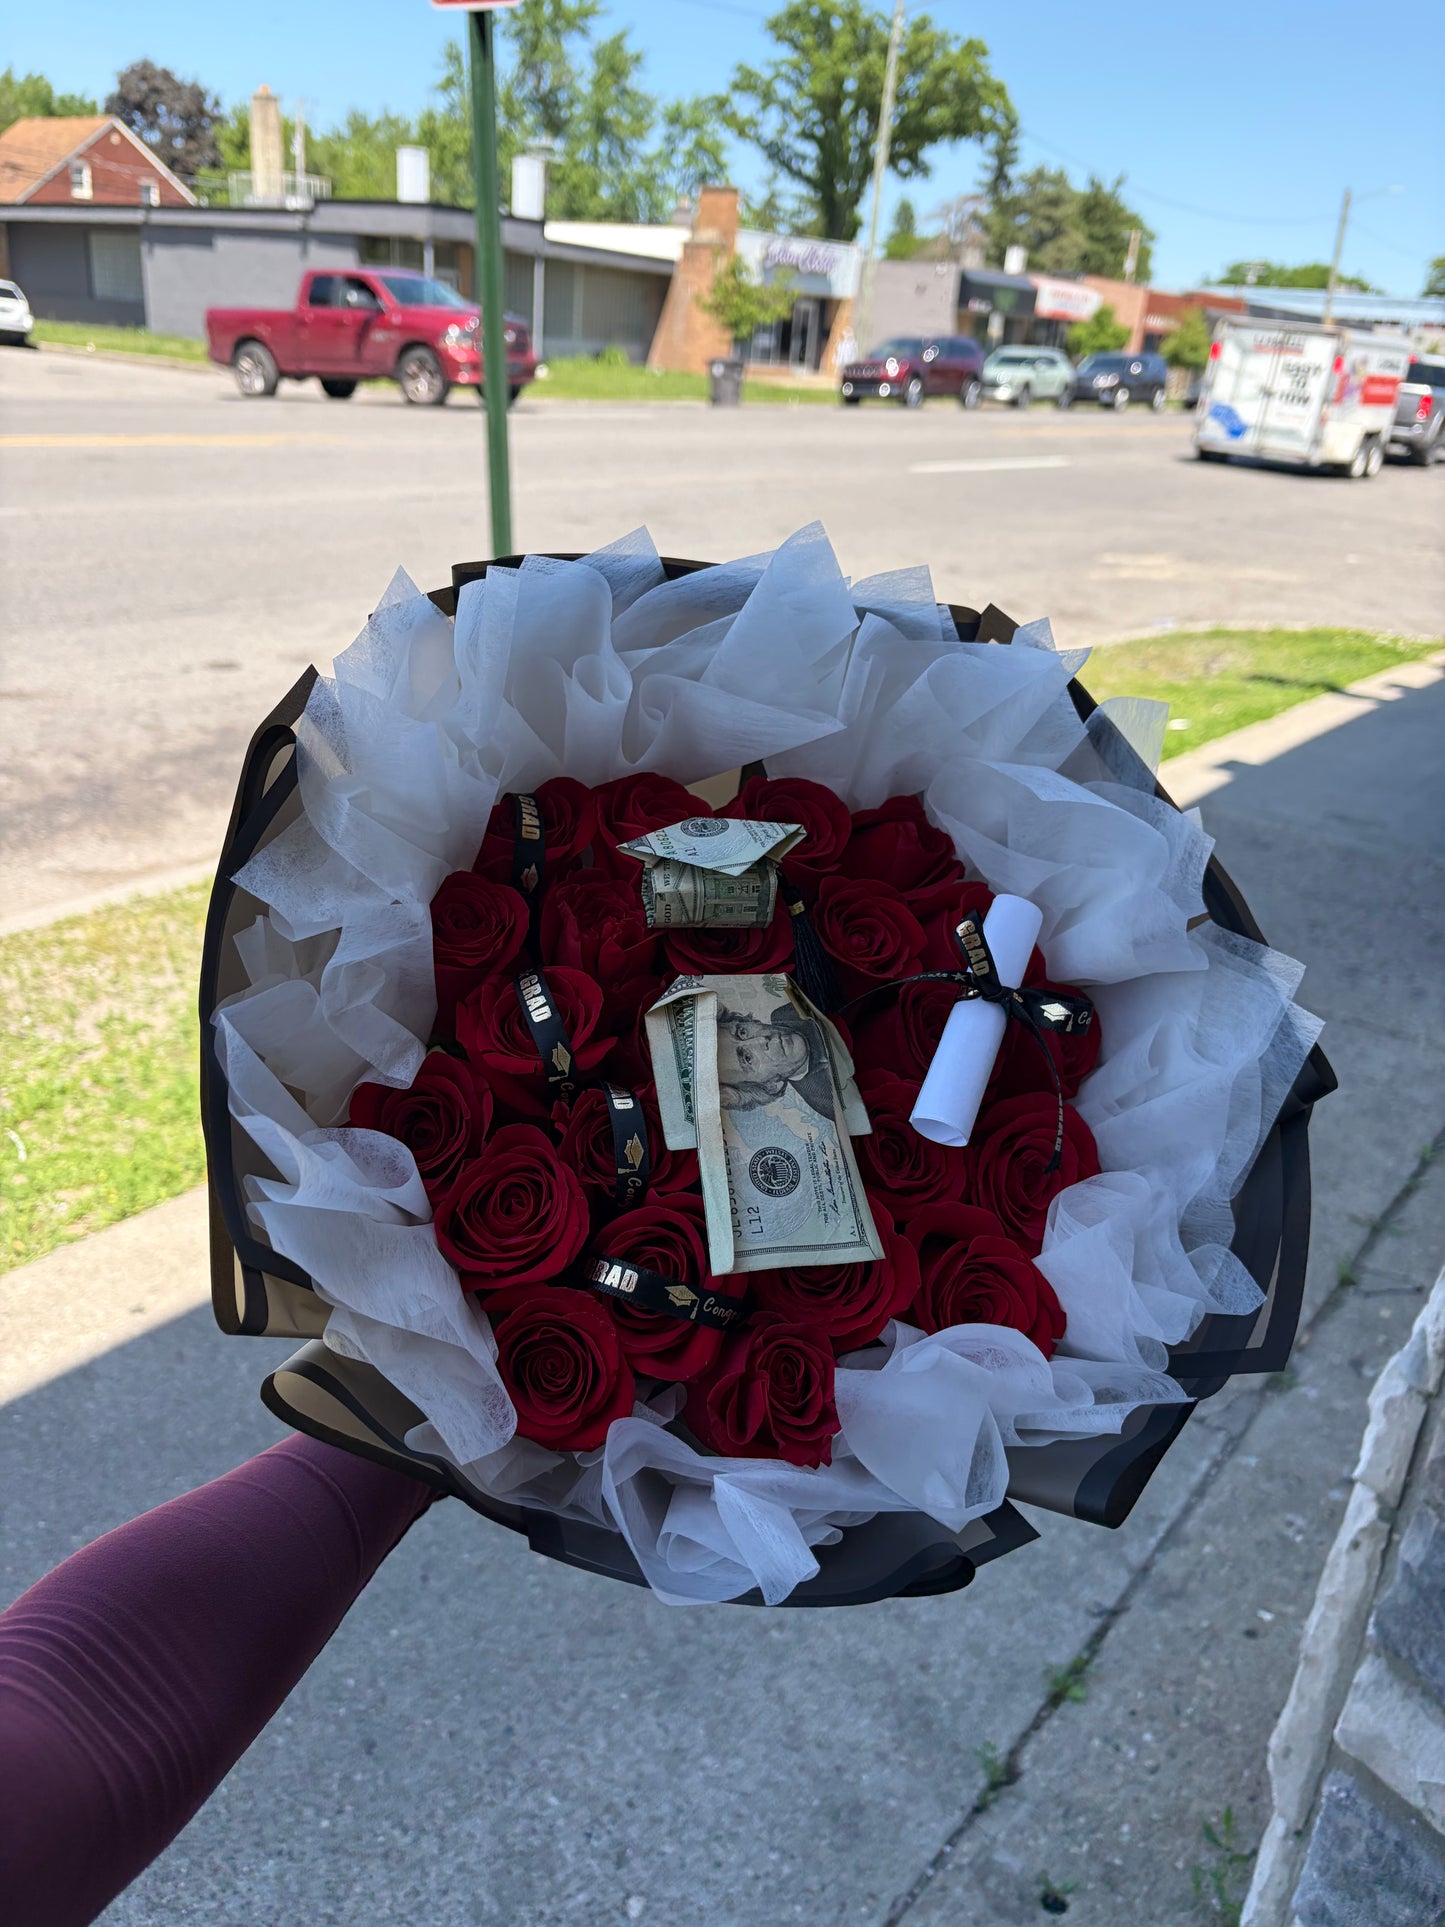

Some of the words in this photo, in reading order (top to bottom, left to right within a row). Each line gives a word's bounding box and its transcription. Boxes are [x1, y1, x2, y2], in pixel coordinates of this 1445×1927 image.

[518, 795, 540, 840] GRAD
[663, 873, 671, 887] WE
[664, 903, 672, 924] GOD
[955, 919, 990, 977] GRAD
[519, 974, 552, 1023] GRAD
[805, 1143, 813, 1162] TENDER
[809, 1162, 817, 1178] LEGAL
[747, 1206, 764, 1235] L12
[592, 1258, 639, 1293] RAD
